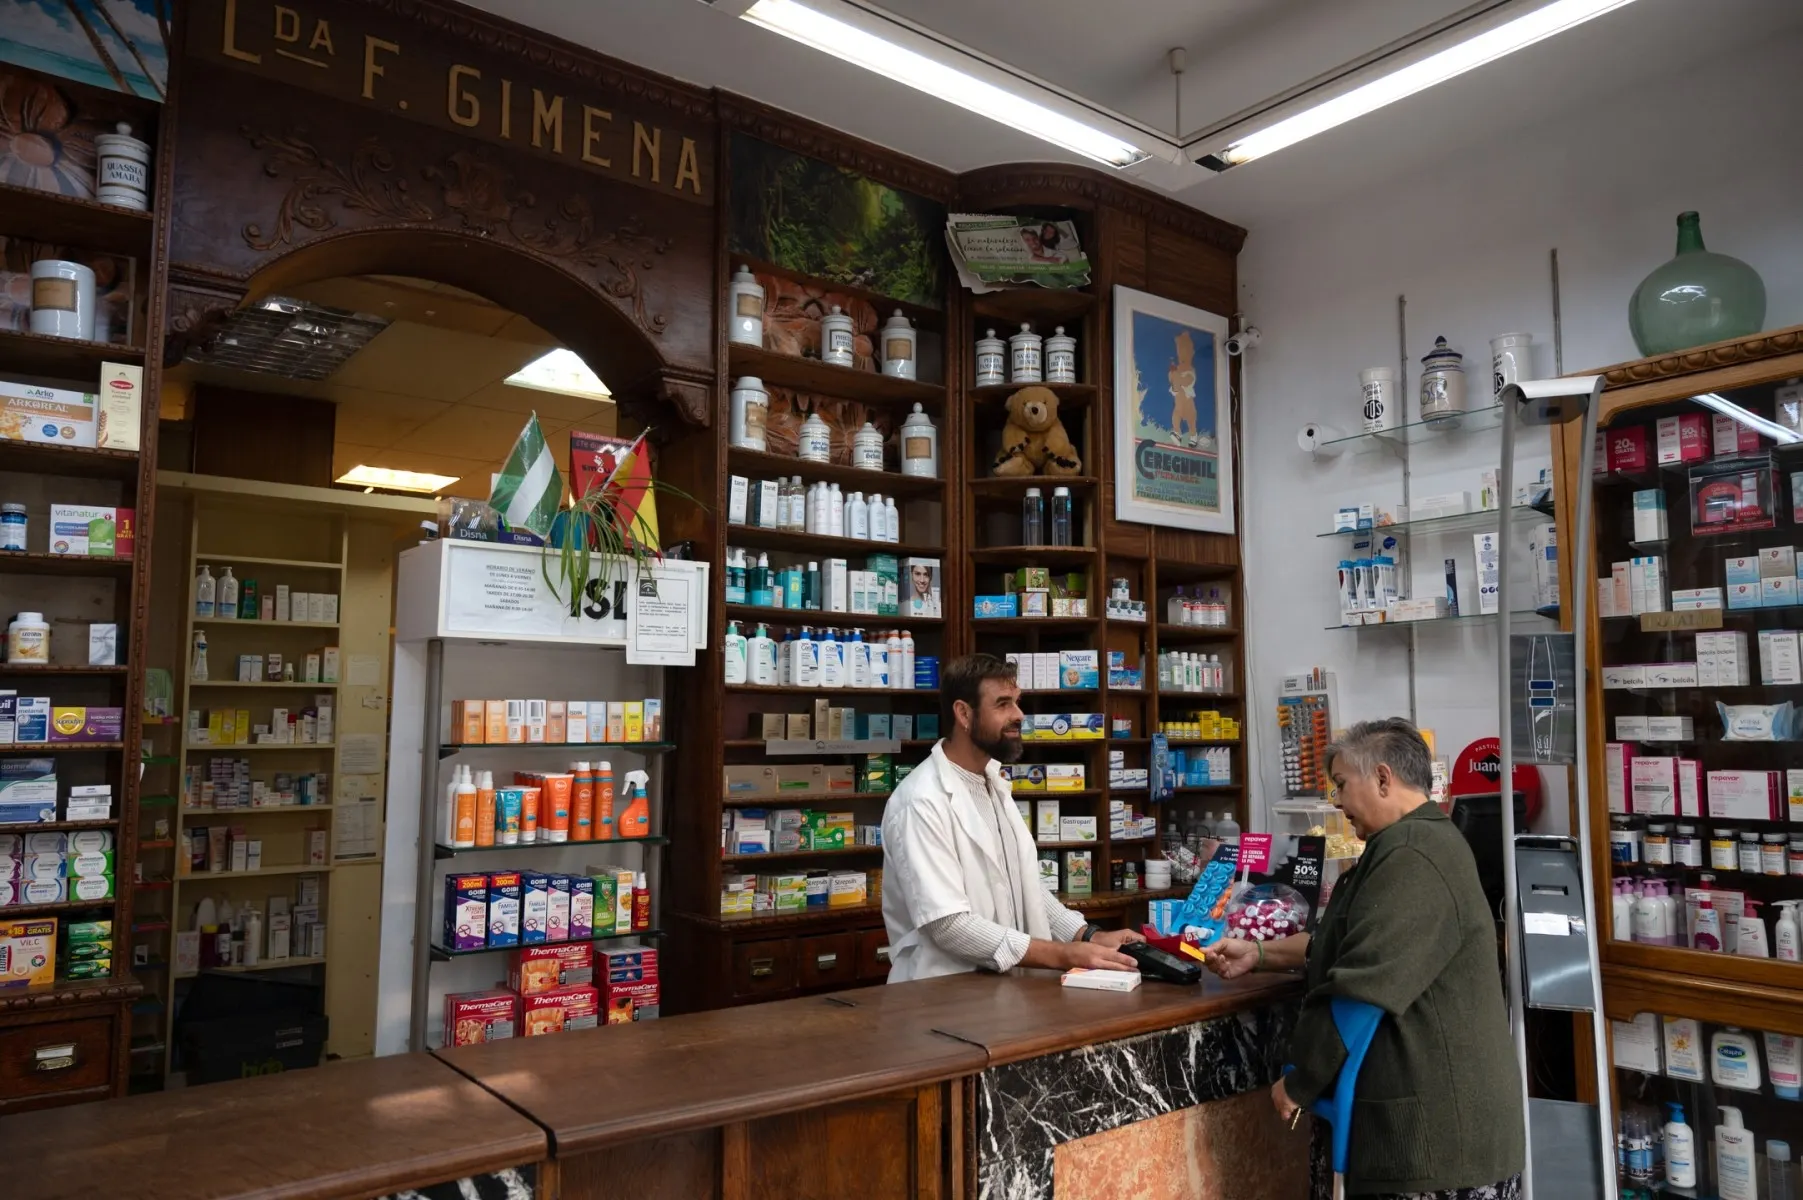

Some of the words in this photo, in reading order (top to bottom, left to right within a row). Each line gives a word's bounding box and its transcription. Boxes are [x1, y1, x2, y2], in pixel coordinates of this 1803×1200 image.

[447, 63, 702, 195] GIMENA
[106, 161, 144, 177] QUASSIA
[108, 170, 142, 185] AMARA
[36, 388, 54, 398] Arko
[1364, 401, 1383, 415] TOS
[1136, 439, 1218, 480] CEREGUMIL
[55, 508, 98, 518] vitanatur
[124, 520, 130, 530] 1
[460, 528, 488, 540] Disna
[514, 534, 532, 543] Disna
[1066, 654, 1091, 662] Nexcare
[1622, 677, 1644, 685] belcils
[1672, 676, 1694, 684] belcils
[1710, 775, 1740, 783] repavar
[1062, 818, 1091, 826] Gastropan
[1294, 864, 1318, 876] 50%
[462, 880, 482, 889] 200ml
[496, 878, 515, 886] 200ml
[498, 902, 518, 910] FAMILIA
[28, 926, 52, 935] GRATIS
[530, 944, 588, 956] ThermaCare
[612, 983, 658, 994] ThermaCare
[534, 992, 593, 1005] ThermaCare
[459, 999, 513, 1012] ThermaCare
[1718, 1046, 1745, 1056] Cetaphil
[1720, 1132, 1743, 1142] Eucerin
